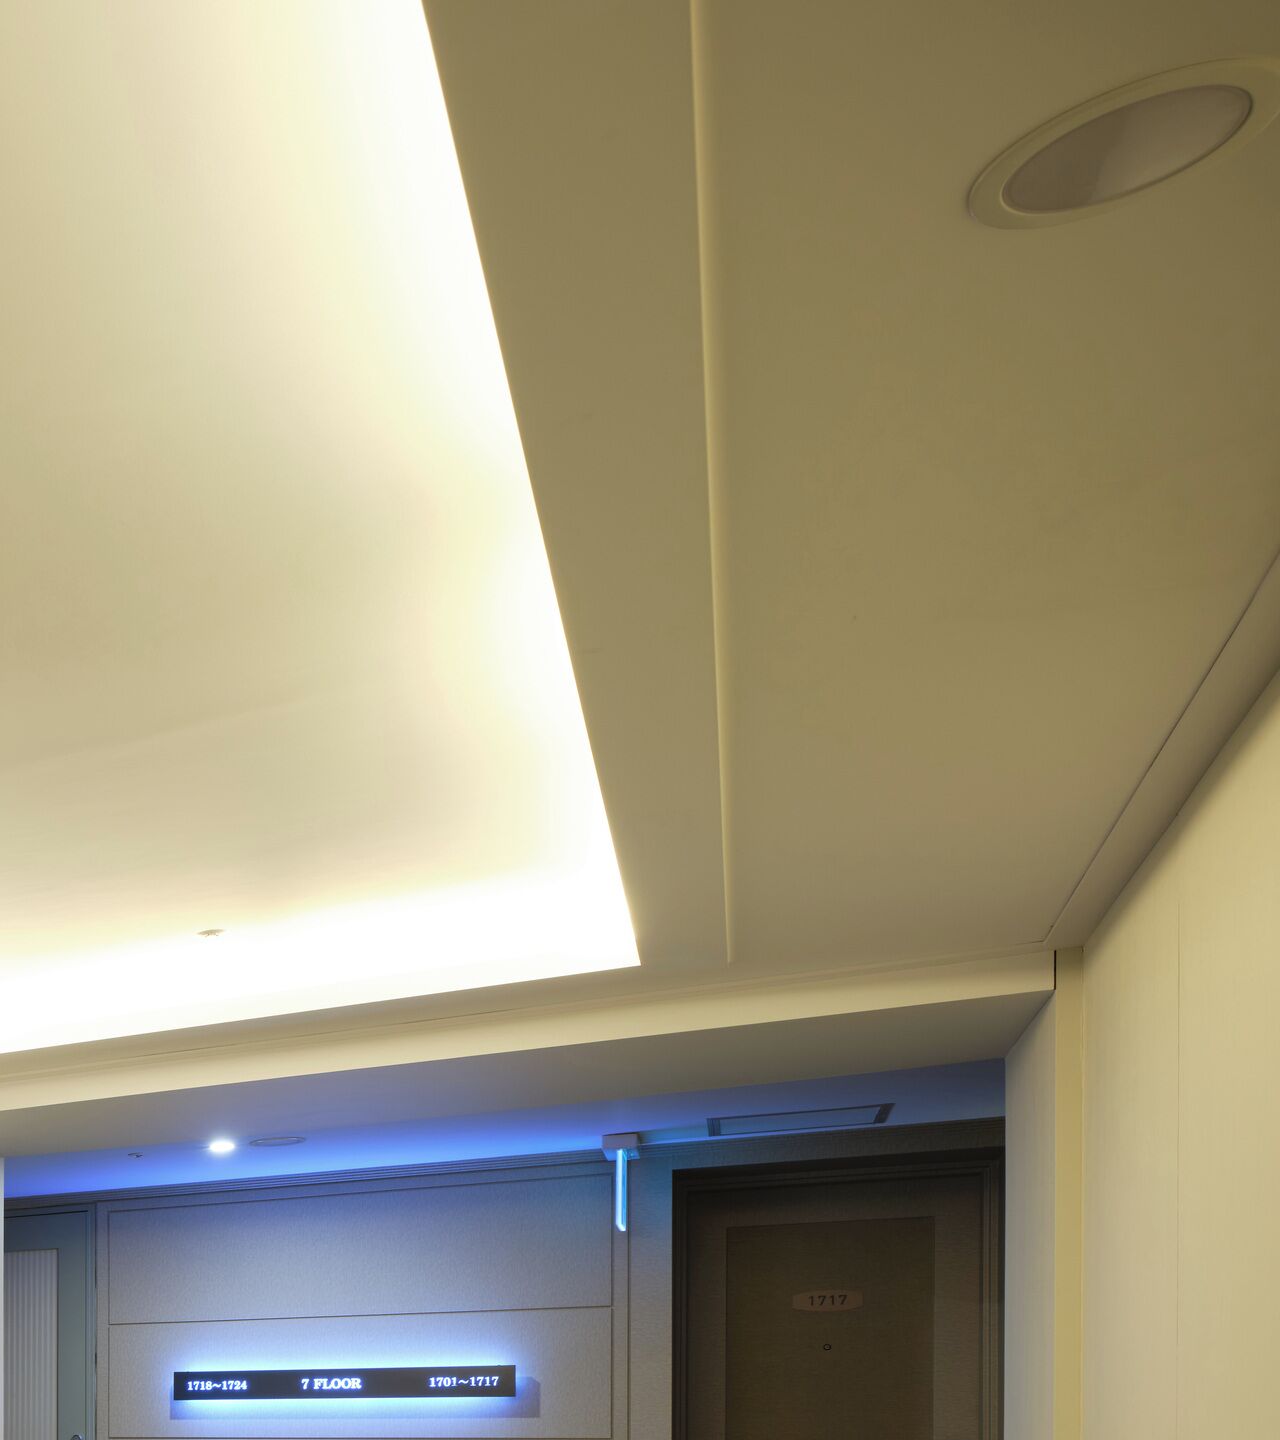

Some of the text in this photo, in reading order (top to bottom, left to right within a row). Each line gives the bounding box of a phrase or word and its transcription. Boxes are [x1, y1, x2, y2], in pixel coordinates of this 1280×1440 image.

[808, 1294, 848, 1306] 1717
[301, 1378, 310, 1390] 7
[313, 1377, 362, 1390] FLOOR
